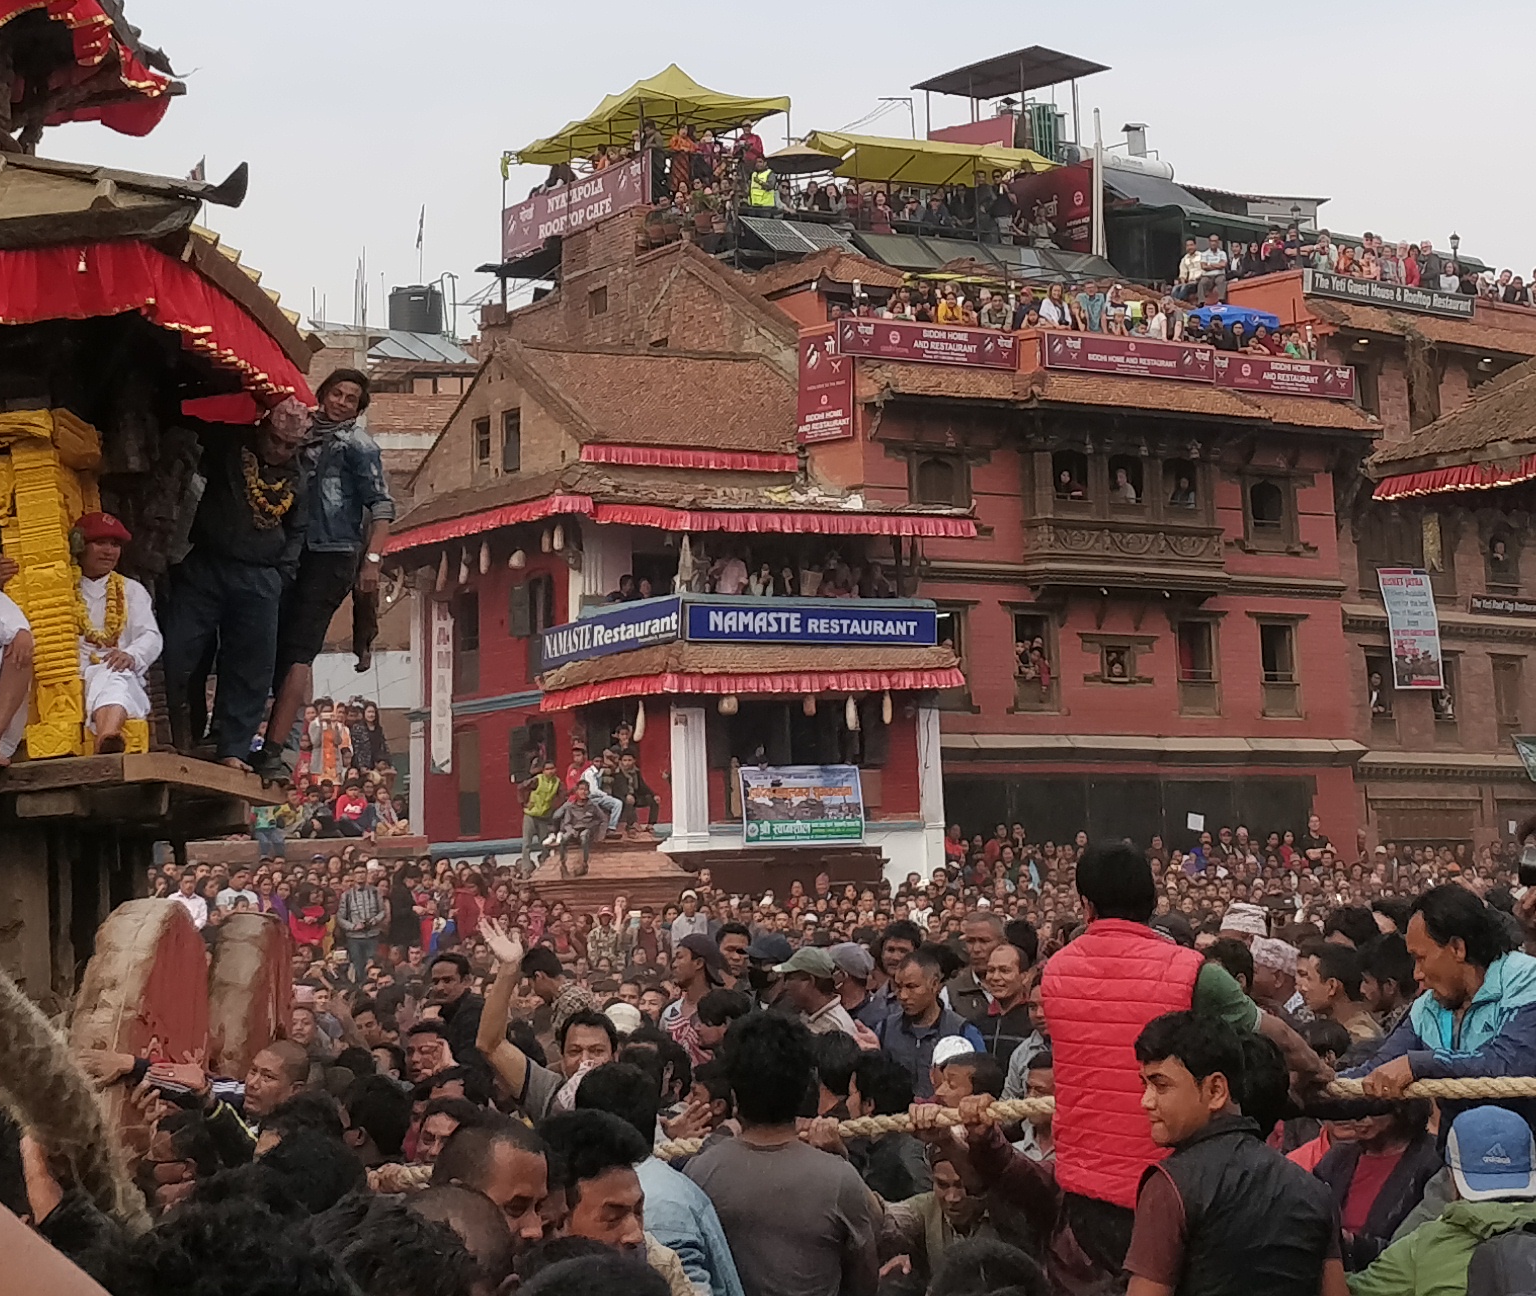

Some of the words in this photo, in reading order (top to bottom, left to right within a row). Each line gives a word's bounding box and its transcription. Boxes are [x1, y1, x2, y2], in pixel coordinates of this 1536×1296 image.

[586, 193, 612, 221] CAFÉ
[1315, 273, 1329, 290] The
[1331, 276, 1346, 293] Yeti
[1347, 280, 1370, 297] Guest
[1370, 285, 1394, 301] House
[1396, 289, 1402, 301] &
[1403, 289, 1431, 308] Rooftop
[1433, 294, 1472, 313] Restaurant
[913, 340, 929, 349] AND
[930, 341, 977, 353] RESTAURANT
[1139, 357, 1176, 368] RESTAURANT
[1262, 372, 1276, 380] AND
[1277, 373, 1318, 384] RESTAURANT
[812, 417, 850, 430] RESTAURANT
[1472, 598, 1482, 608] The
[1482, 599, 1492, 609] Yeti
[709, 610, 801, 635] NAMASTE
[807, 618, 918, 636] RESTAURANT
[544, 622, 593, 660] NAMASTE
[593, 611, 678, 647] Restaurant
